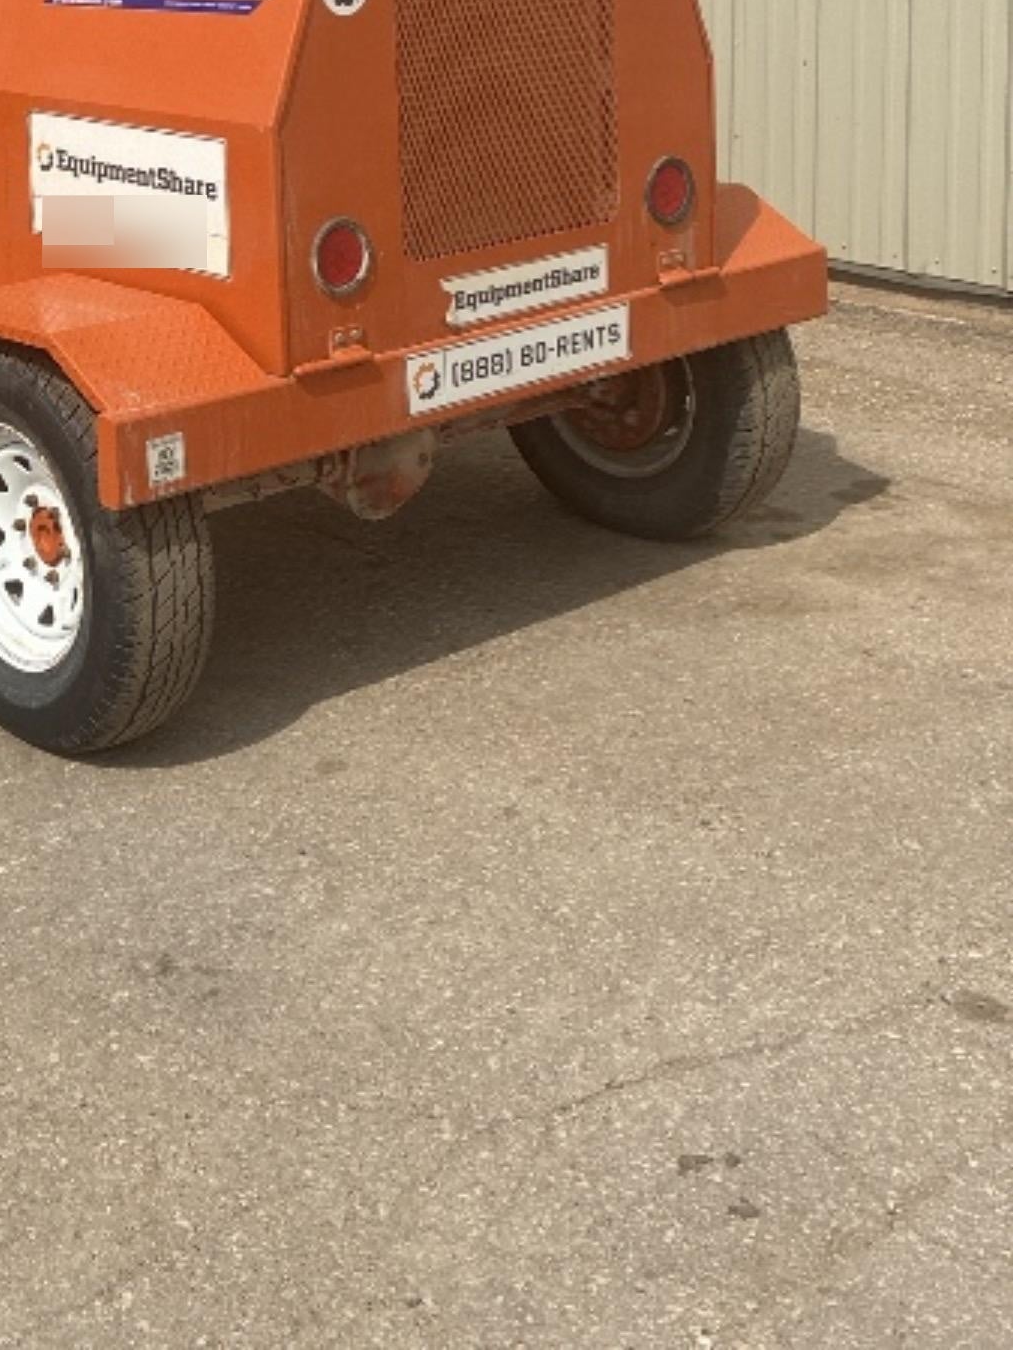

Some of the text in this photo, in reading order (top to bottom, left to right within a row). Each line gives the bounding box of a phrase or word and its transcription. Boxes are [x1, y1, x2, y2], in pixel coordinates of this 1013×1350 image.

[55, 149, 218, 201] EquipmentShare
[454, 263, 600, 311] EquipmentShare
[451, 349, 513, 388] (888)
